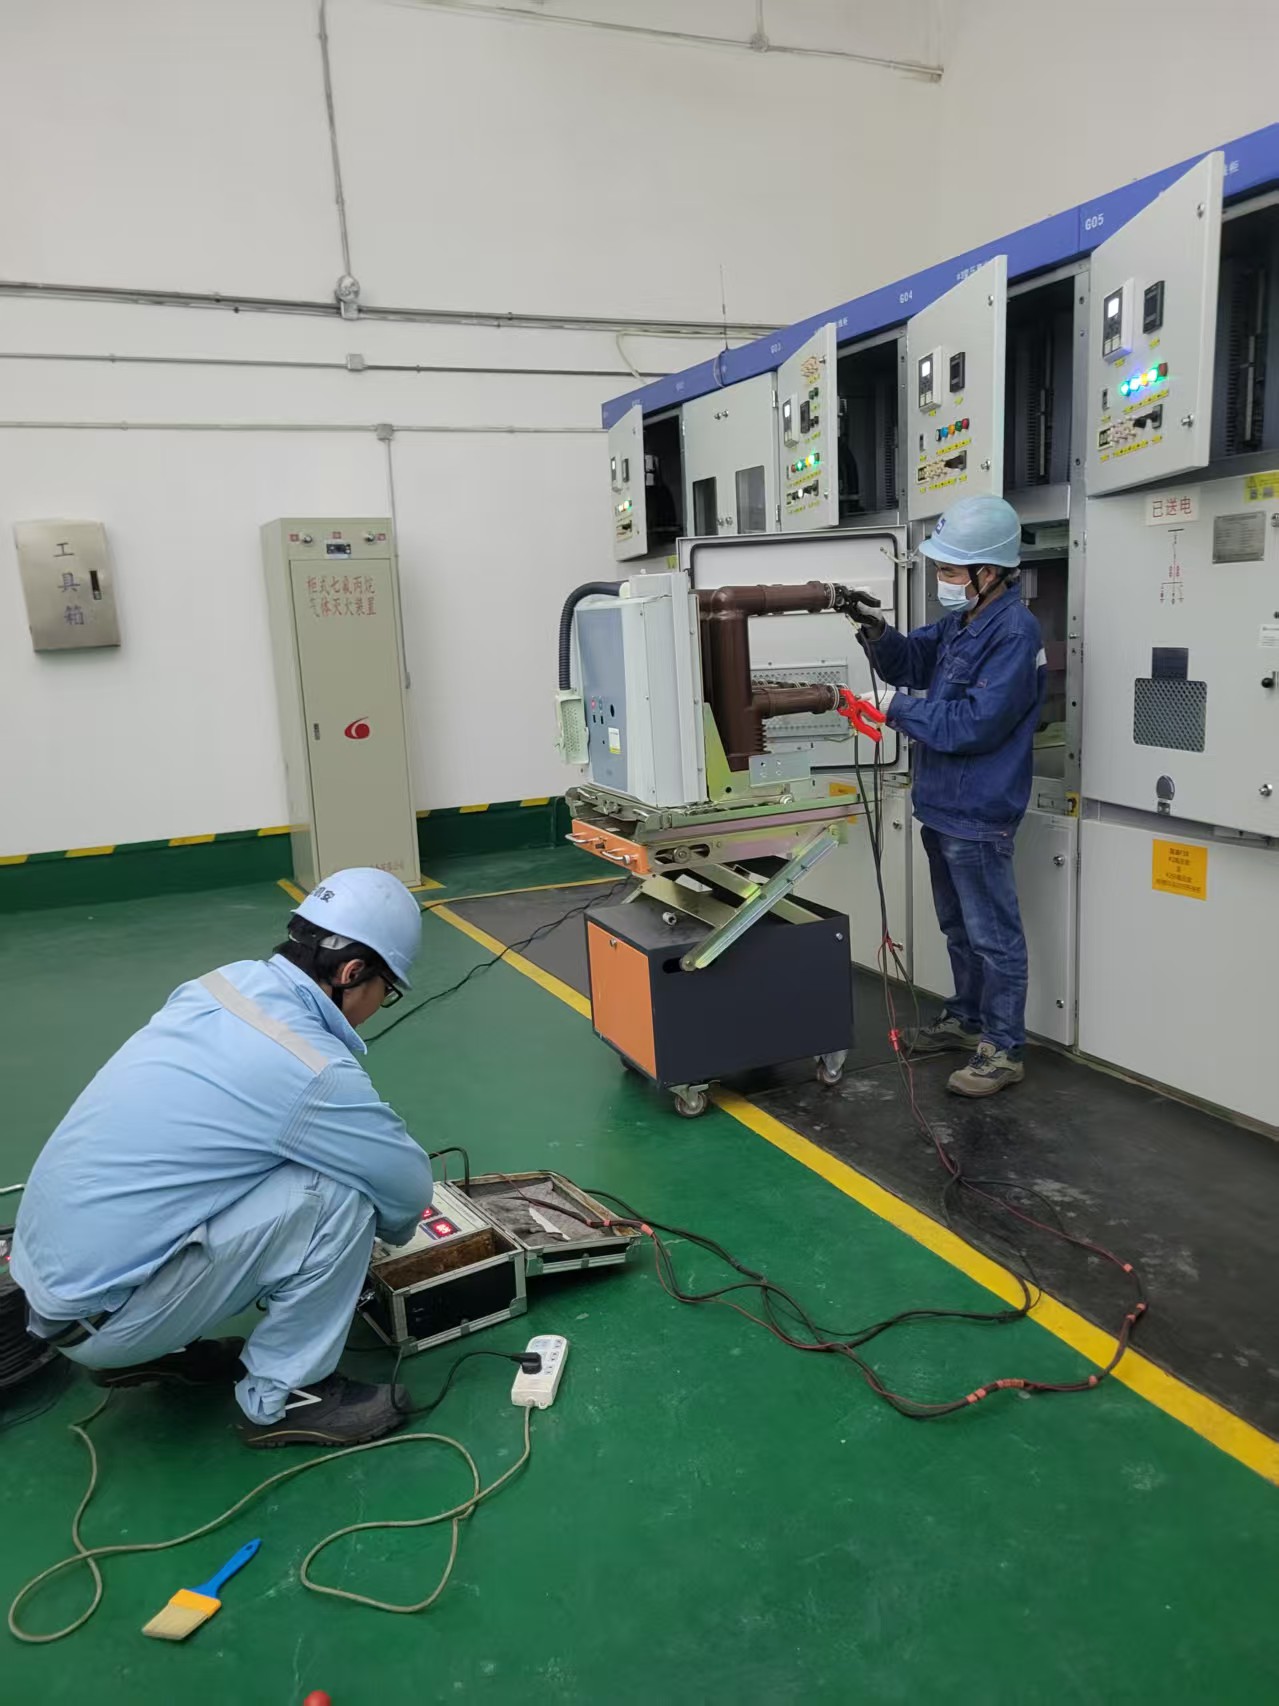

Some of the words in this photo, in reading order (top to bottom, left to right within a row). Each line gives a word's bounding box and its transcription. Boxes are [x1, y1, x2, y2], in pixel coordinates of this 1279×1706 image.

[1085, 213, 1104, 230] G05
[899, 290, 913, 303] G04
[1152, 496, 1191, 518] 已送电
[53, 542, 84, 625] 工具箱
